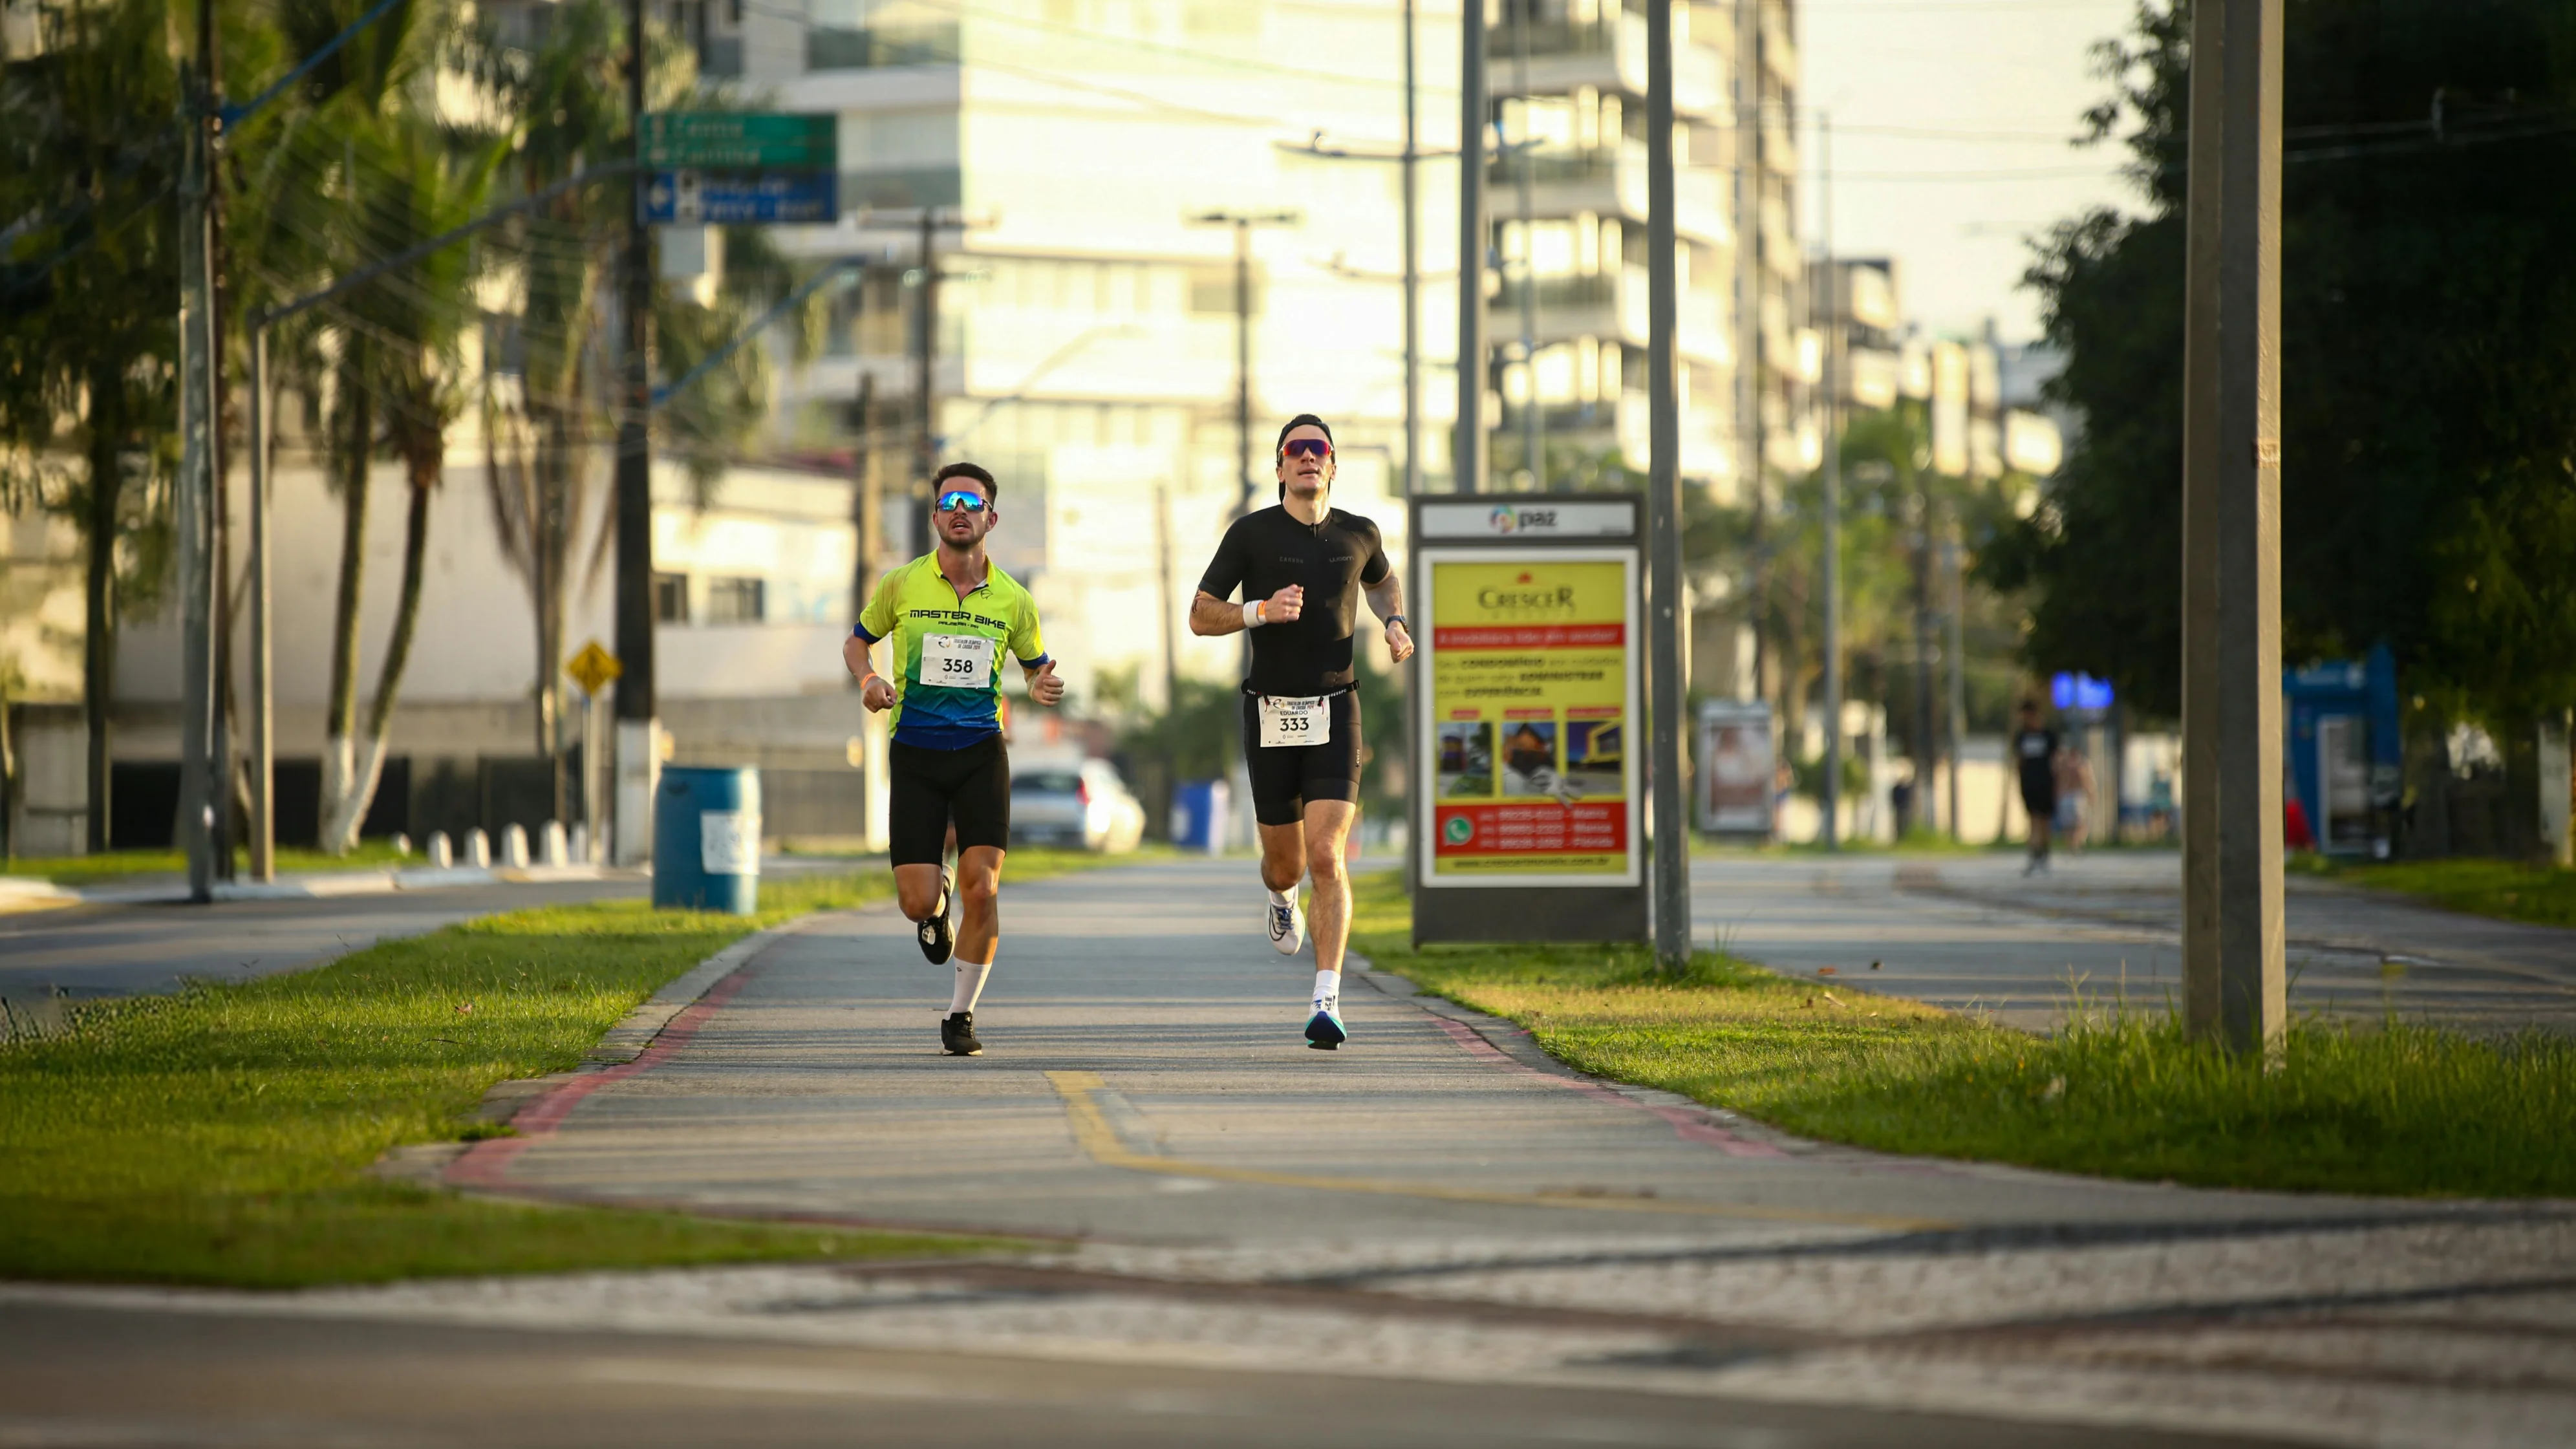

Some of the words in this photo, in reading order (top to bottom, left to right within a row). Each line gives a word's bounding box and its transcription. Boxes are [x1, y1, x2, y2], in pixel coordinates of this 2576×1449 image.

[1518, 510, 1558, 531] paz
[910, 610, 971, 621] MASTER
[974, 614, 1006, 630] BIKE
[942, 658, 973, 674] 358
[1280, 717, 1309, 731] 333
